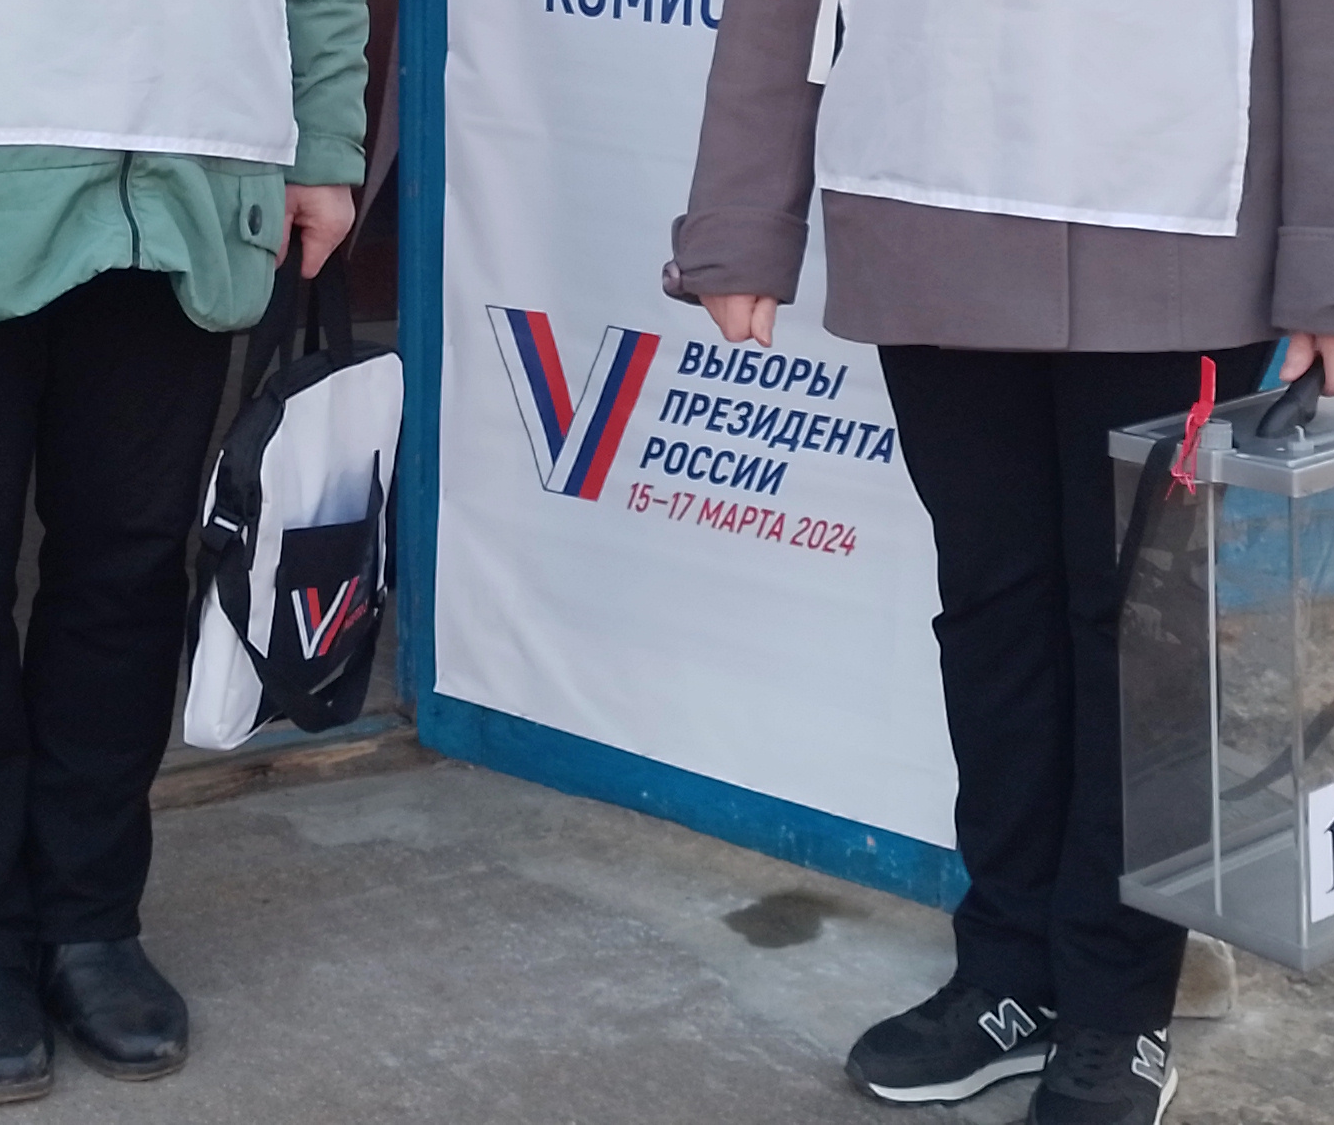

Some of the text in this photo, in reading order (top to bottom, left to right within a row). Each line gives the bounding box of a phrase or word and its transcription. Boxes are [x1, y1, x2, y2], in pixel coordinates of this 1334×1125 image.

[677, 341, 849, 400] ВЫБОРЫ
[659, 389, 895, 463] ПРЕЗИДЕНТА
[640, 436, 789, 495] РОССИИ
[697, 498, 786, 542] МАРТА
[790, 517, 856, 557] 2024
